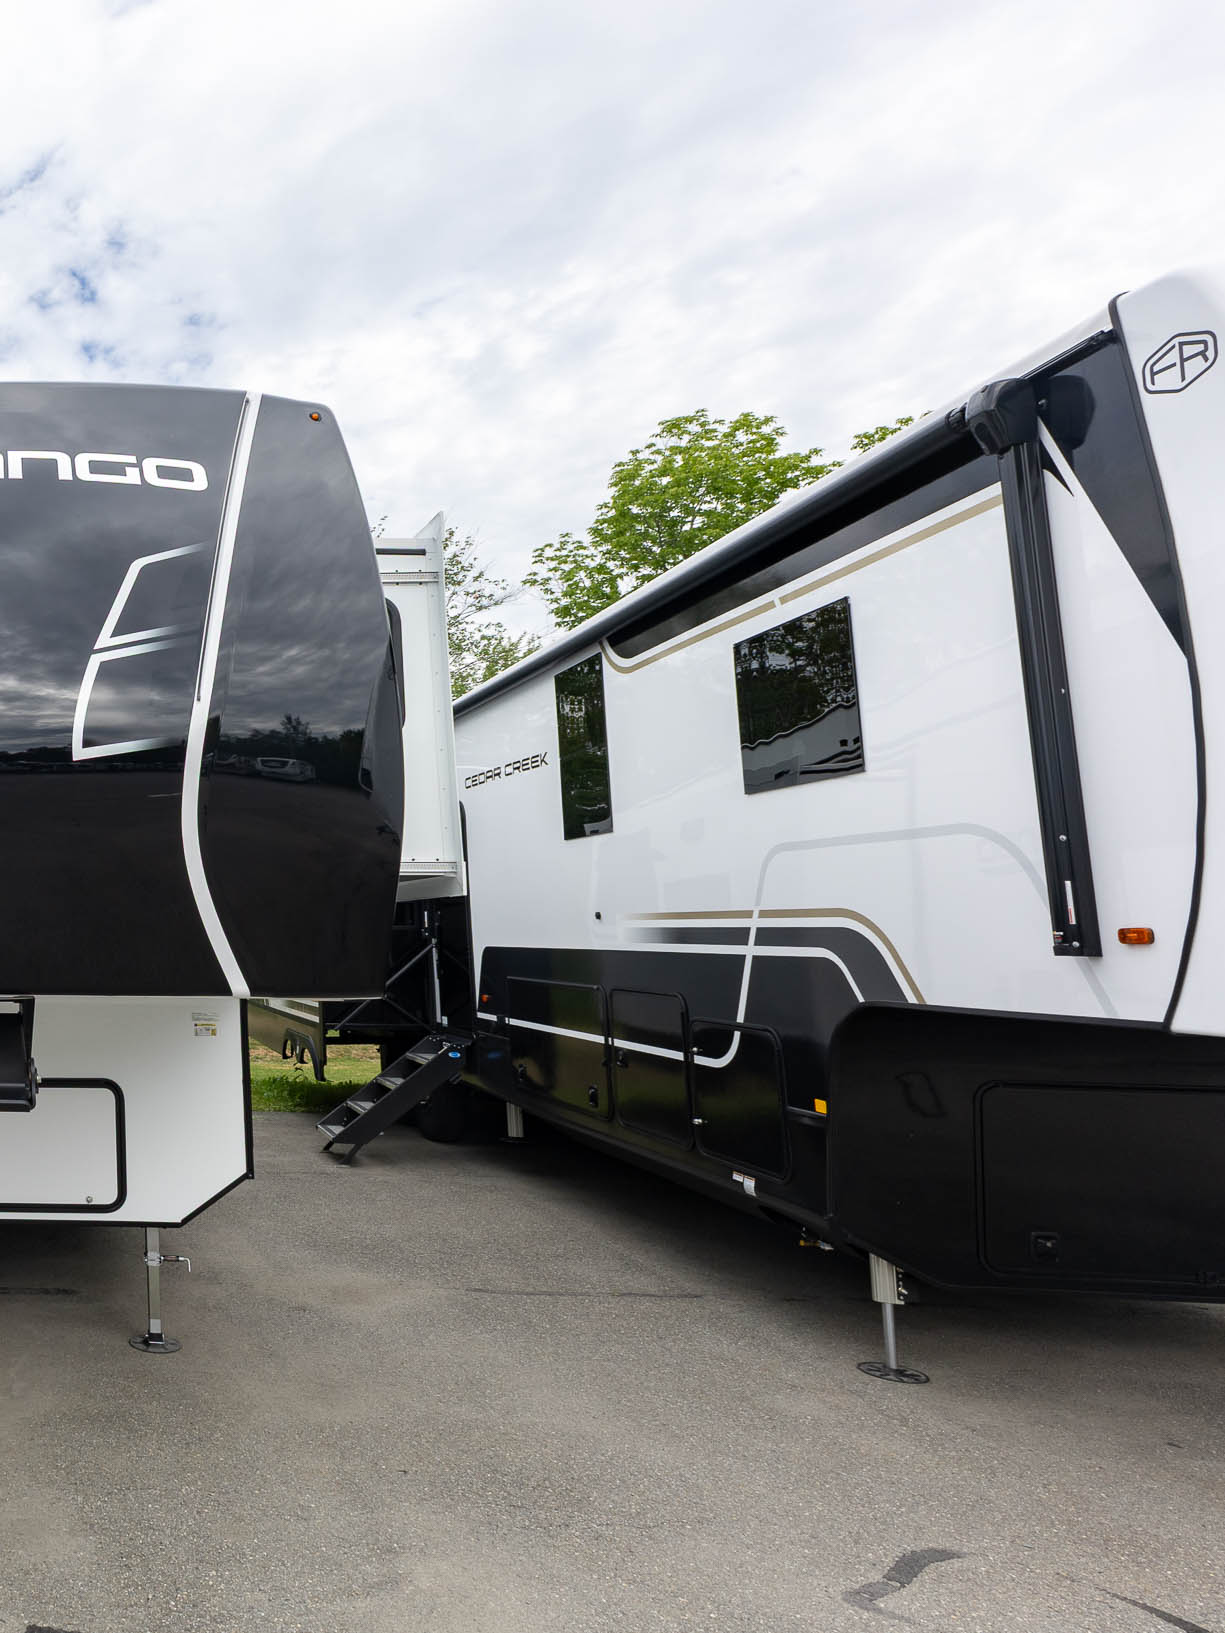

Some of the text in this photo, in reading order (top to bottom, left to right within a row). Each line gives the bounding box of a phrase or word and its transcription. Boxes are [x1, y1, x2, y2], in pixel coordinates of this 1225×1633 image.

[1150, 339, 1209, 385] FR
[464, 751, 549, 789] CEDAR CREEK
